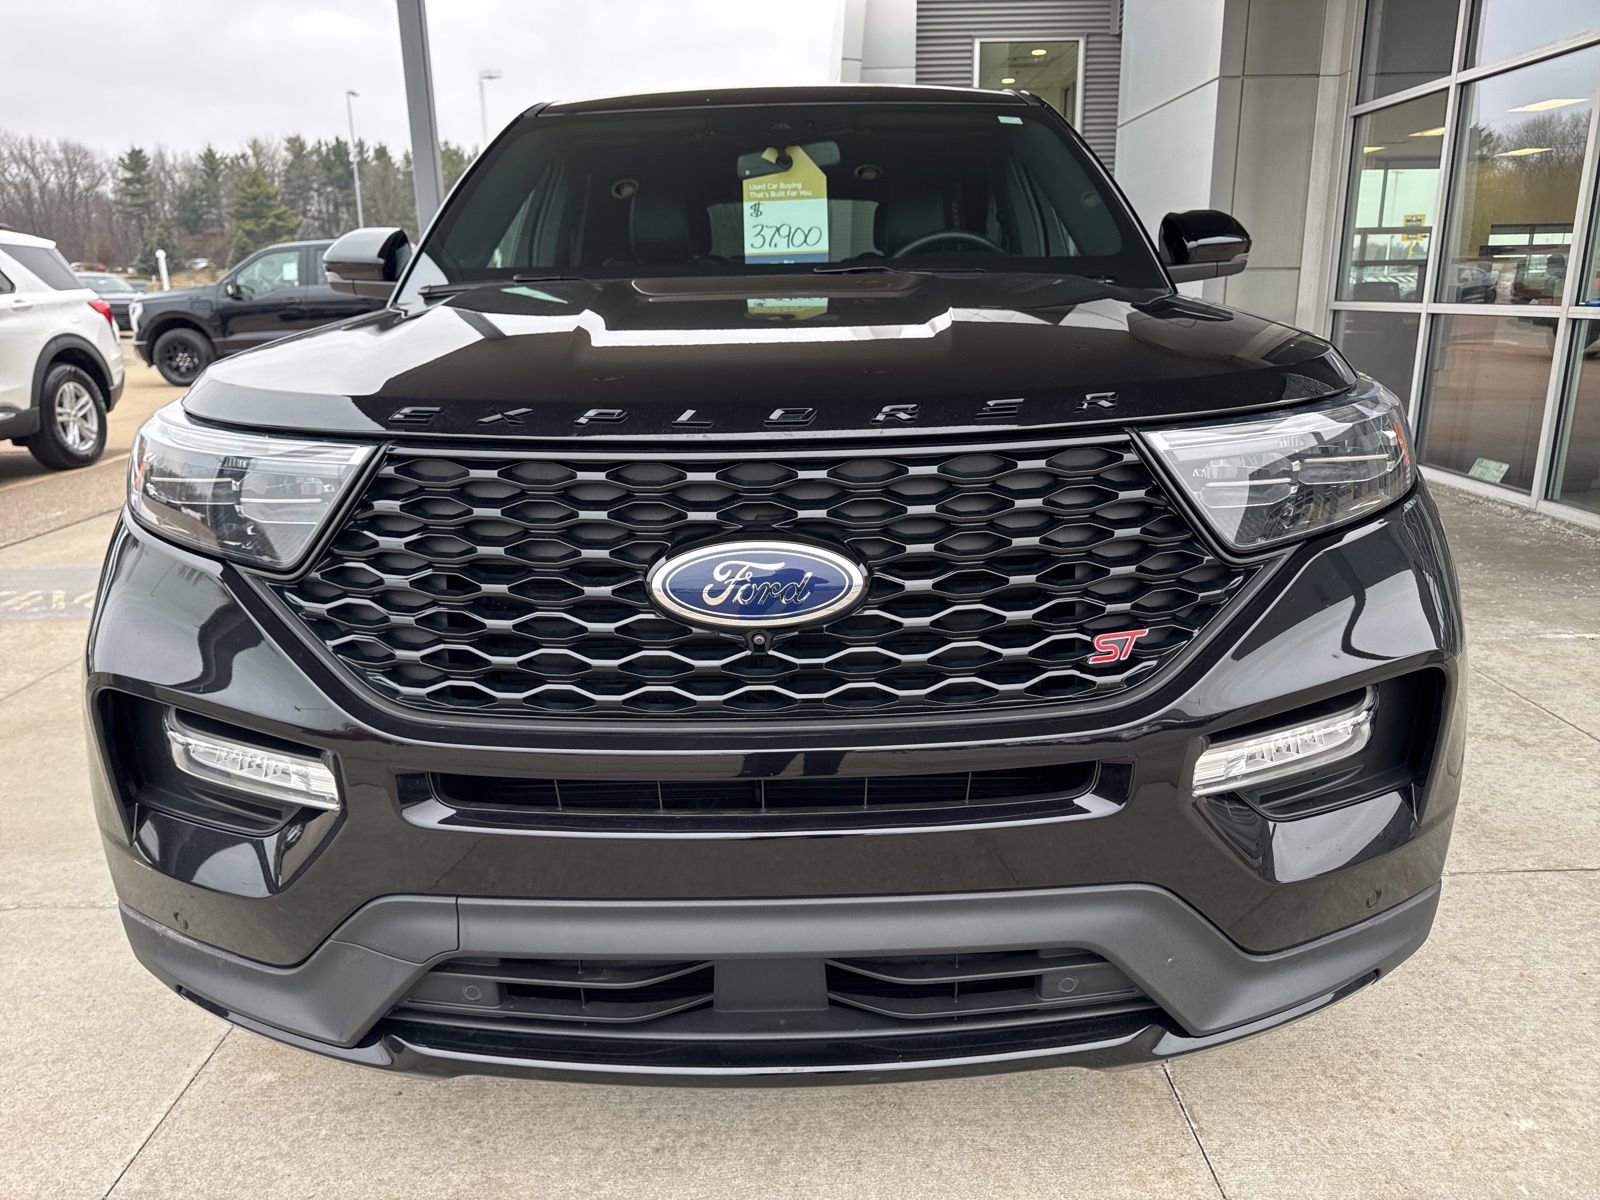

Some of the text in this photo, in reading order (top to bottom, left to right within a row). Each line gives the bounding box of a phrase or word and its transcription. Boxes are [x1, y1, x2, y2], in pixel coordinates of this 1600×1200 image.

[779, 182, 802, 190] Buying
[750, 202, 763, 217] $
[388, 391, 1120, 427] EXPLORER
[702, 560, 813, 606] Ford
[1088, 628, 1149, 664] ST
